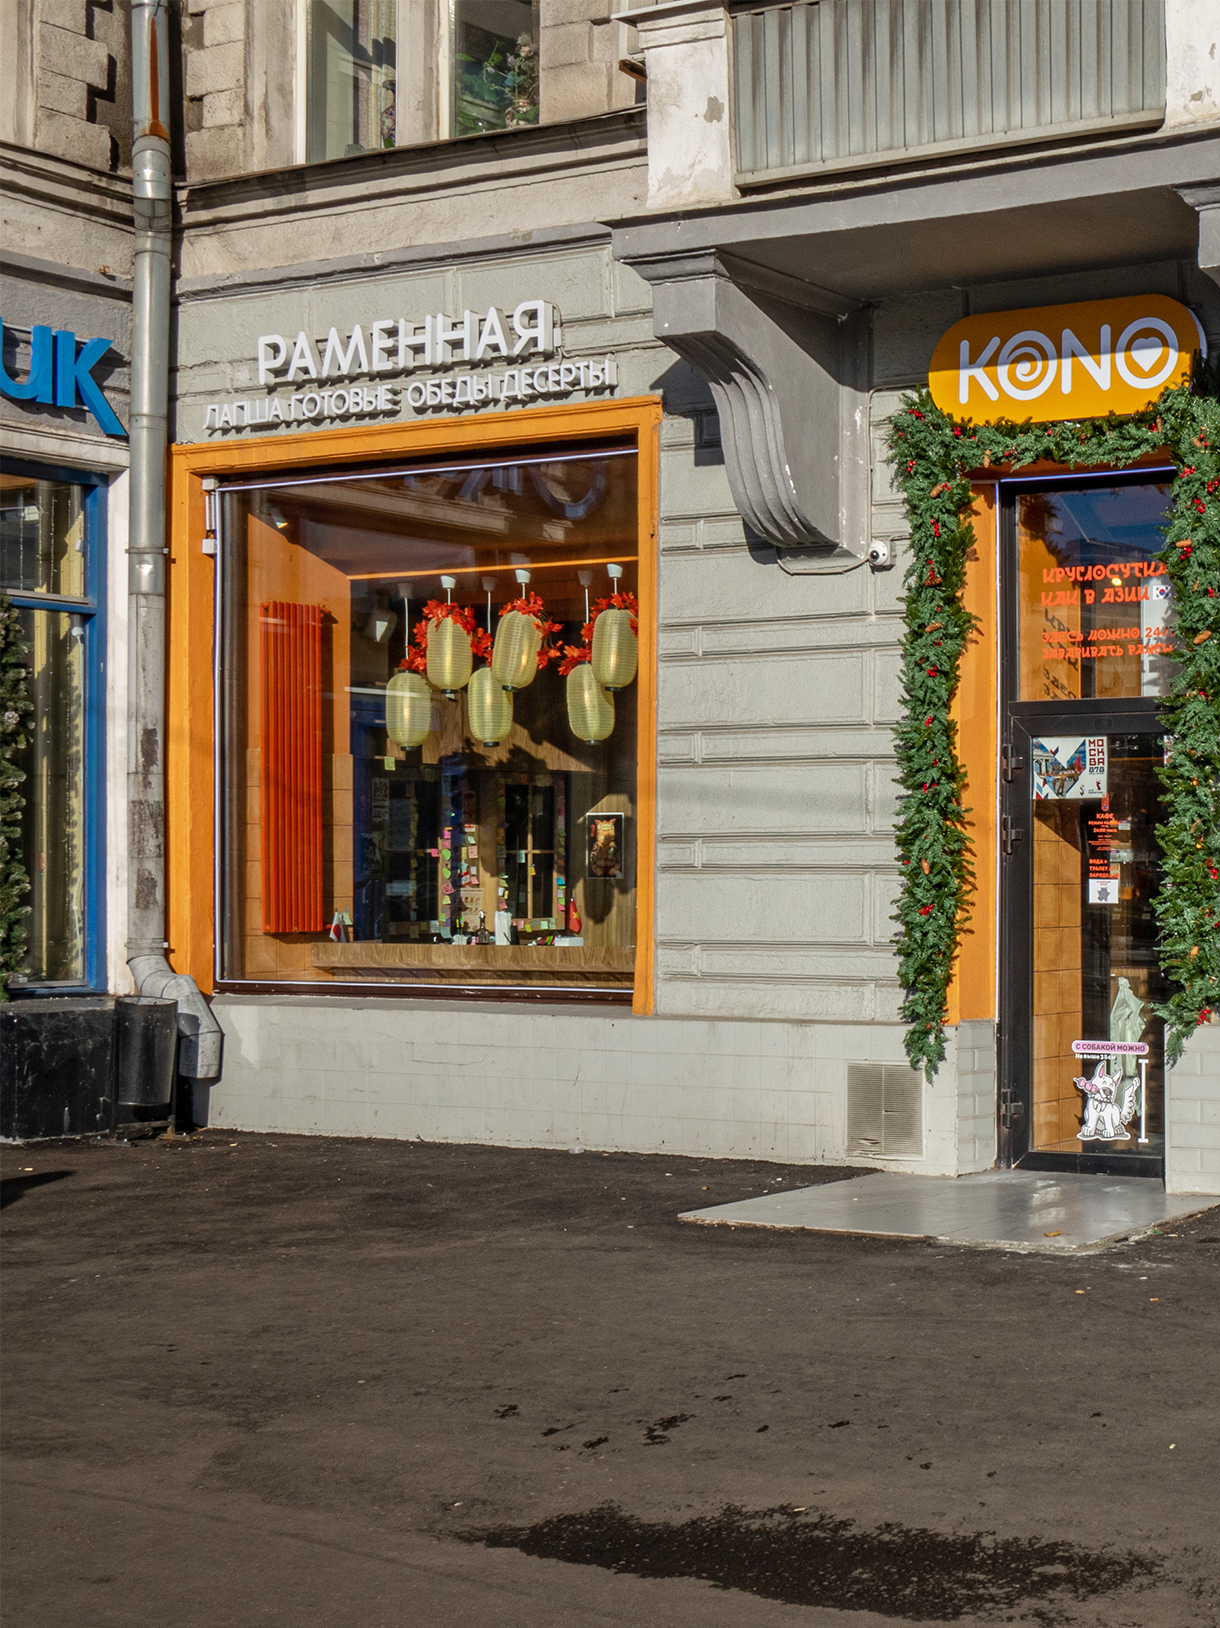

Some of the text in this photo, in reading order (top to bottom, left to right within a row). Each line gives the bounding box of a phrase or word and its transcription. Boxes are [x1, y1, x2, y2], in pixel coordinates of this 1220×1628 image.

[258, 300, 549, 385] РАМЕННАЯ
[959, 317, 1179, 404] KONO
[203, 359, 615, 429] ЛАПША ГОТОВЫЕ ОБЕДЫ ДЕСЕРТЫ
[1043, 561, 1168, 583] КРУГЛОСУТКА
[1041, 586, 1150, 607] КАК В АЗИИ
[1042, 631, 1084, 643] ЗДЕСЬ
[1088, 627, 1140, 641] МОЖНО
[1042, 645, 1124, 659] ЗАВАРИВАТЬ
[1082, 1043, 1116, 1051] СОБАКОЙ
